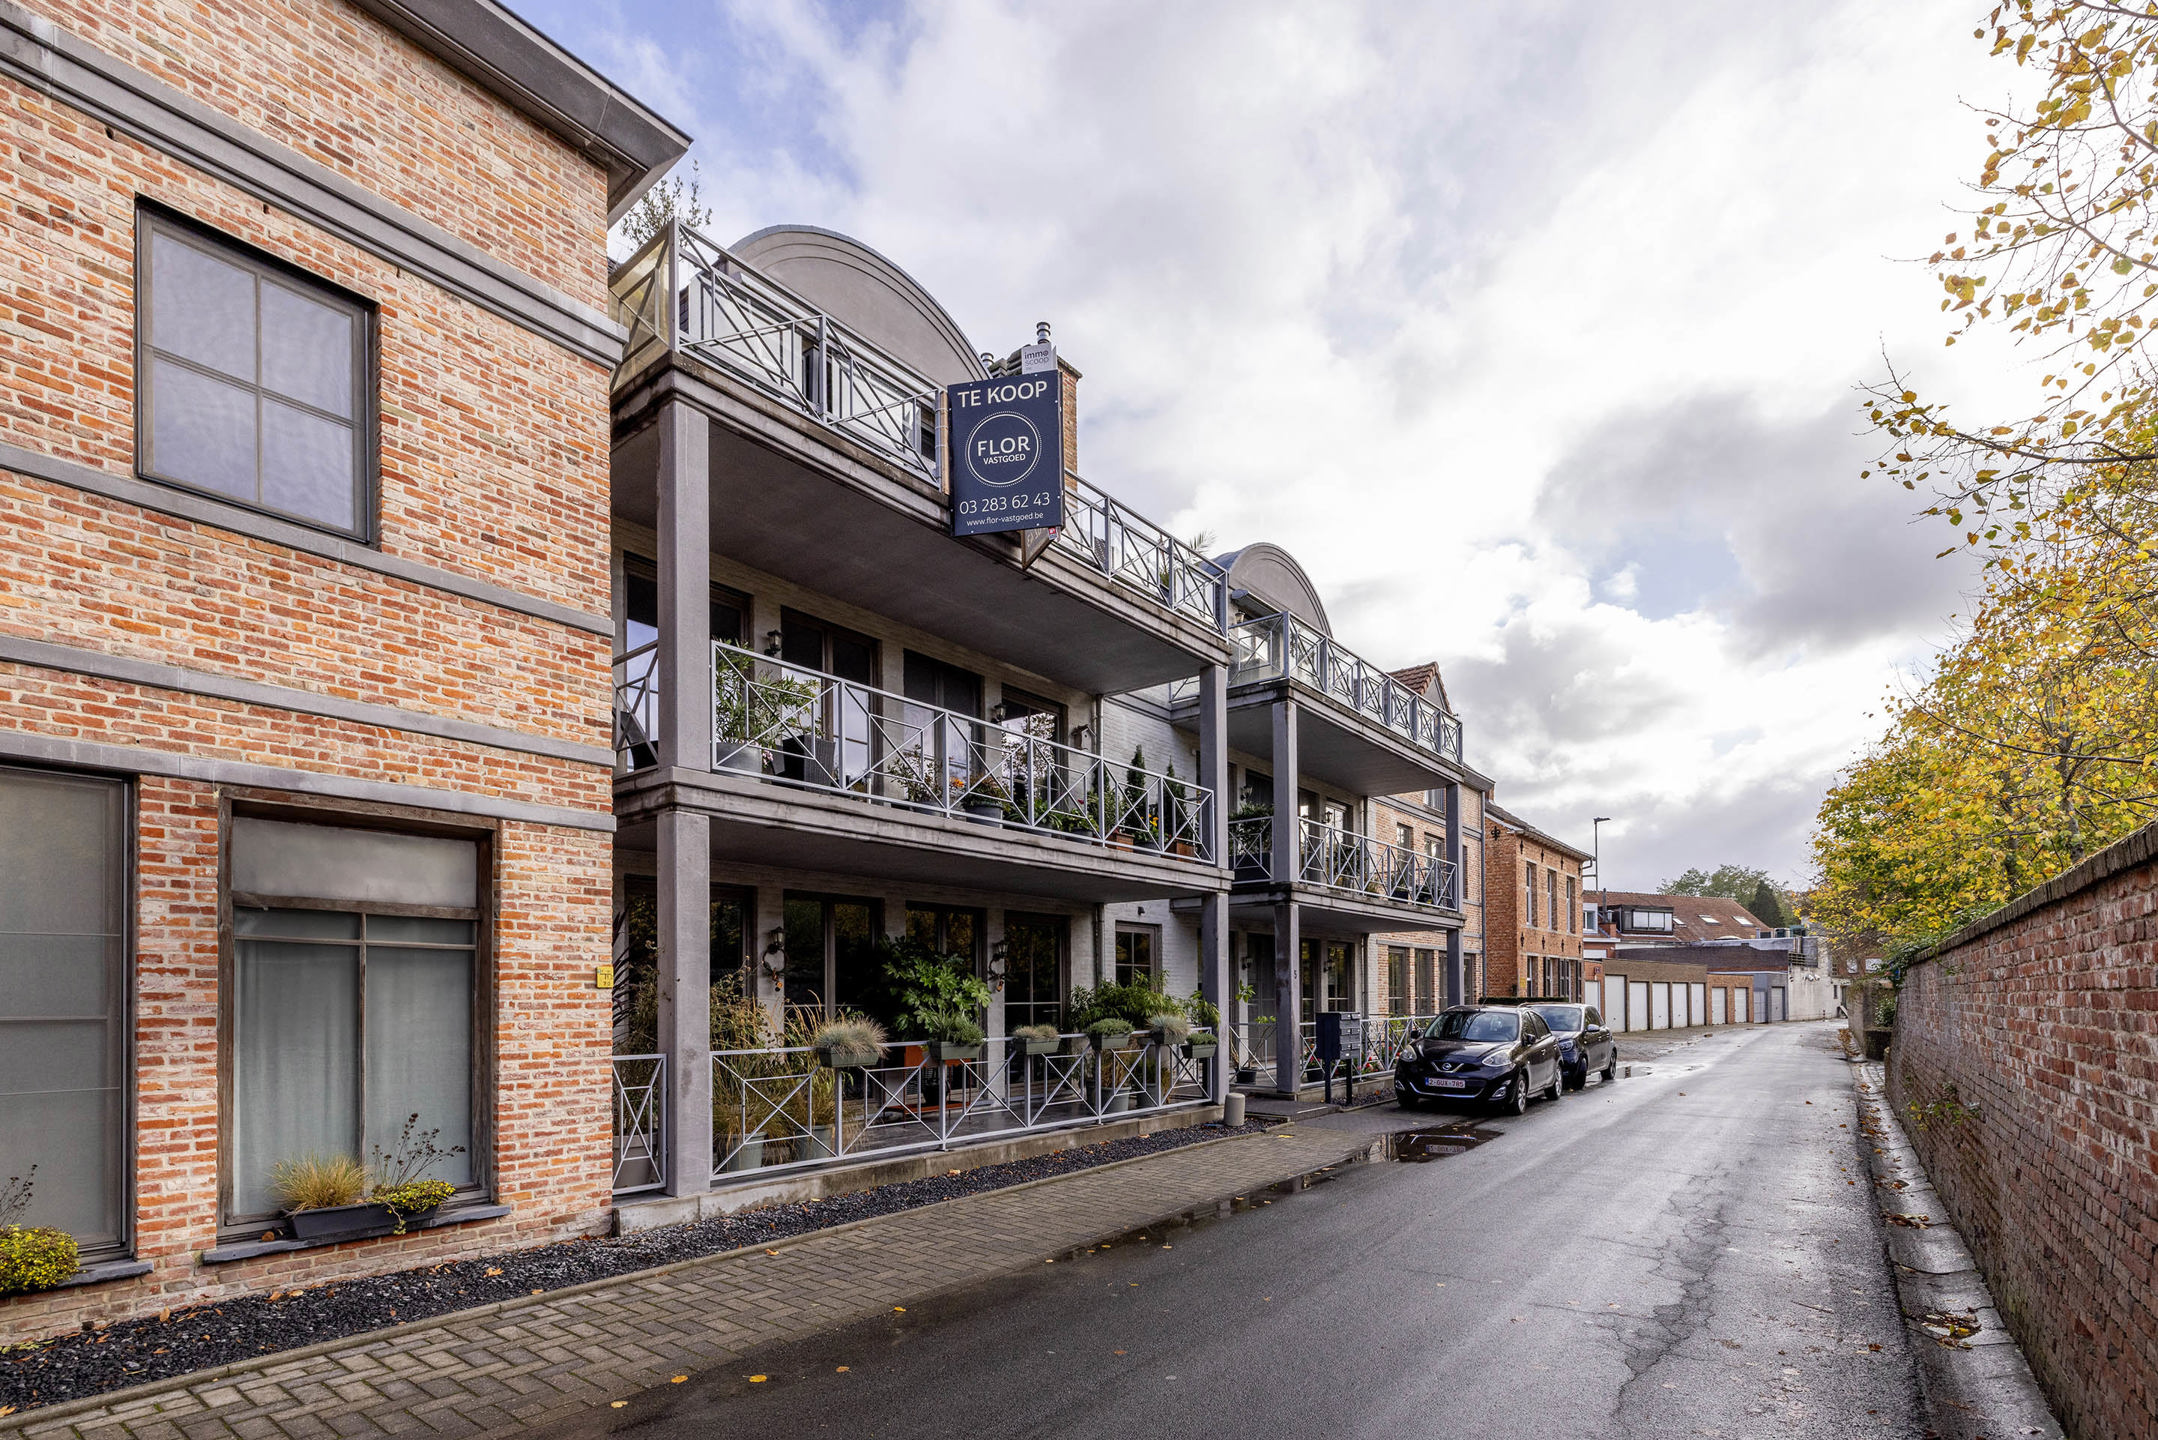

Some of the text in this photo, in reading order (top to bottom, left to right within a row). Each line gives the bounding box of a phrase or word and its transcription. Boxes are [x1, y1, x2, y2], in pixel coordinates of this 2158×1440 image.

[1024, 350, 1049, 359] immo
[1025, 357, 1049, 367] scoop
[957, 380, 1048, 408] TE KOOP
[977, 436, 1031, 457] FLOR
[983, 453, 1026, 465] VASTGOED
[960, 492, 1050, 514] 03 283 62 43
[966, 512, 1044, 527] www.flor-vastgoed.be
